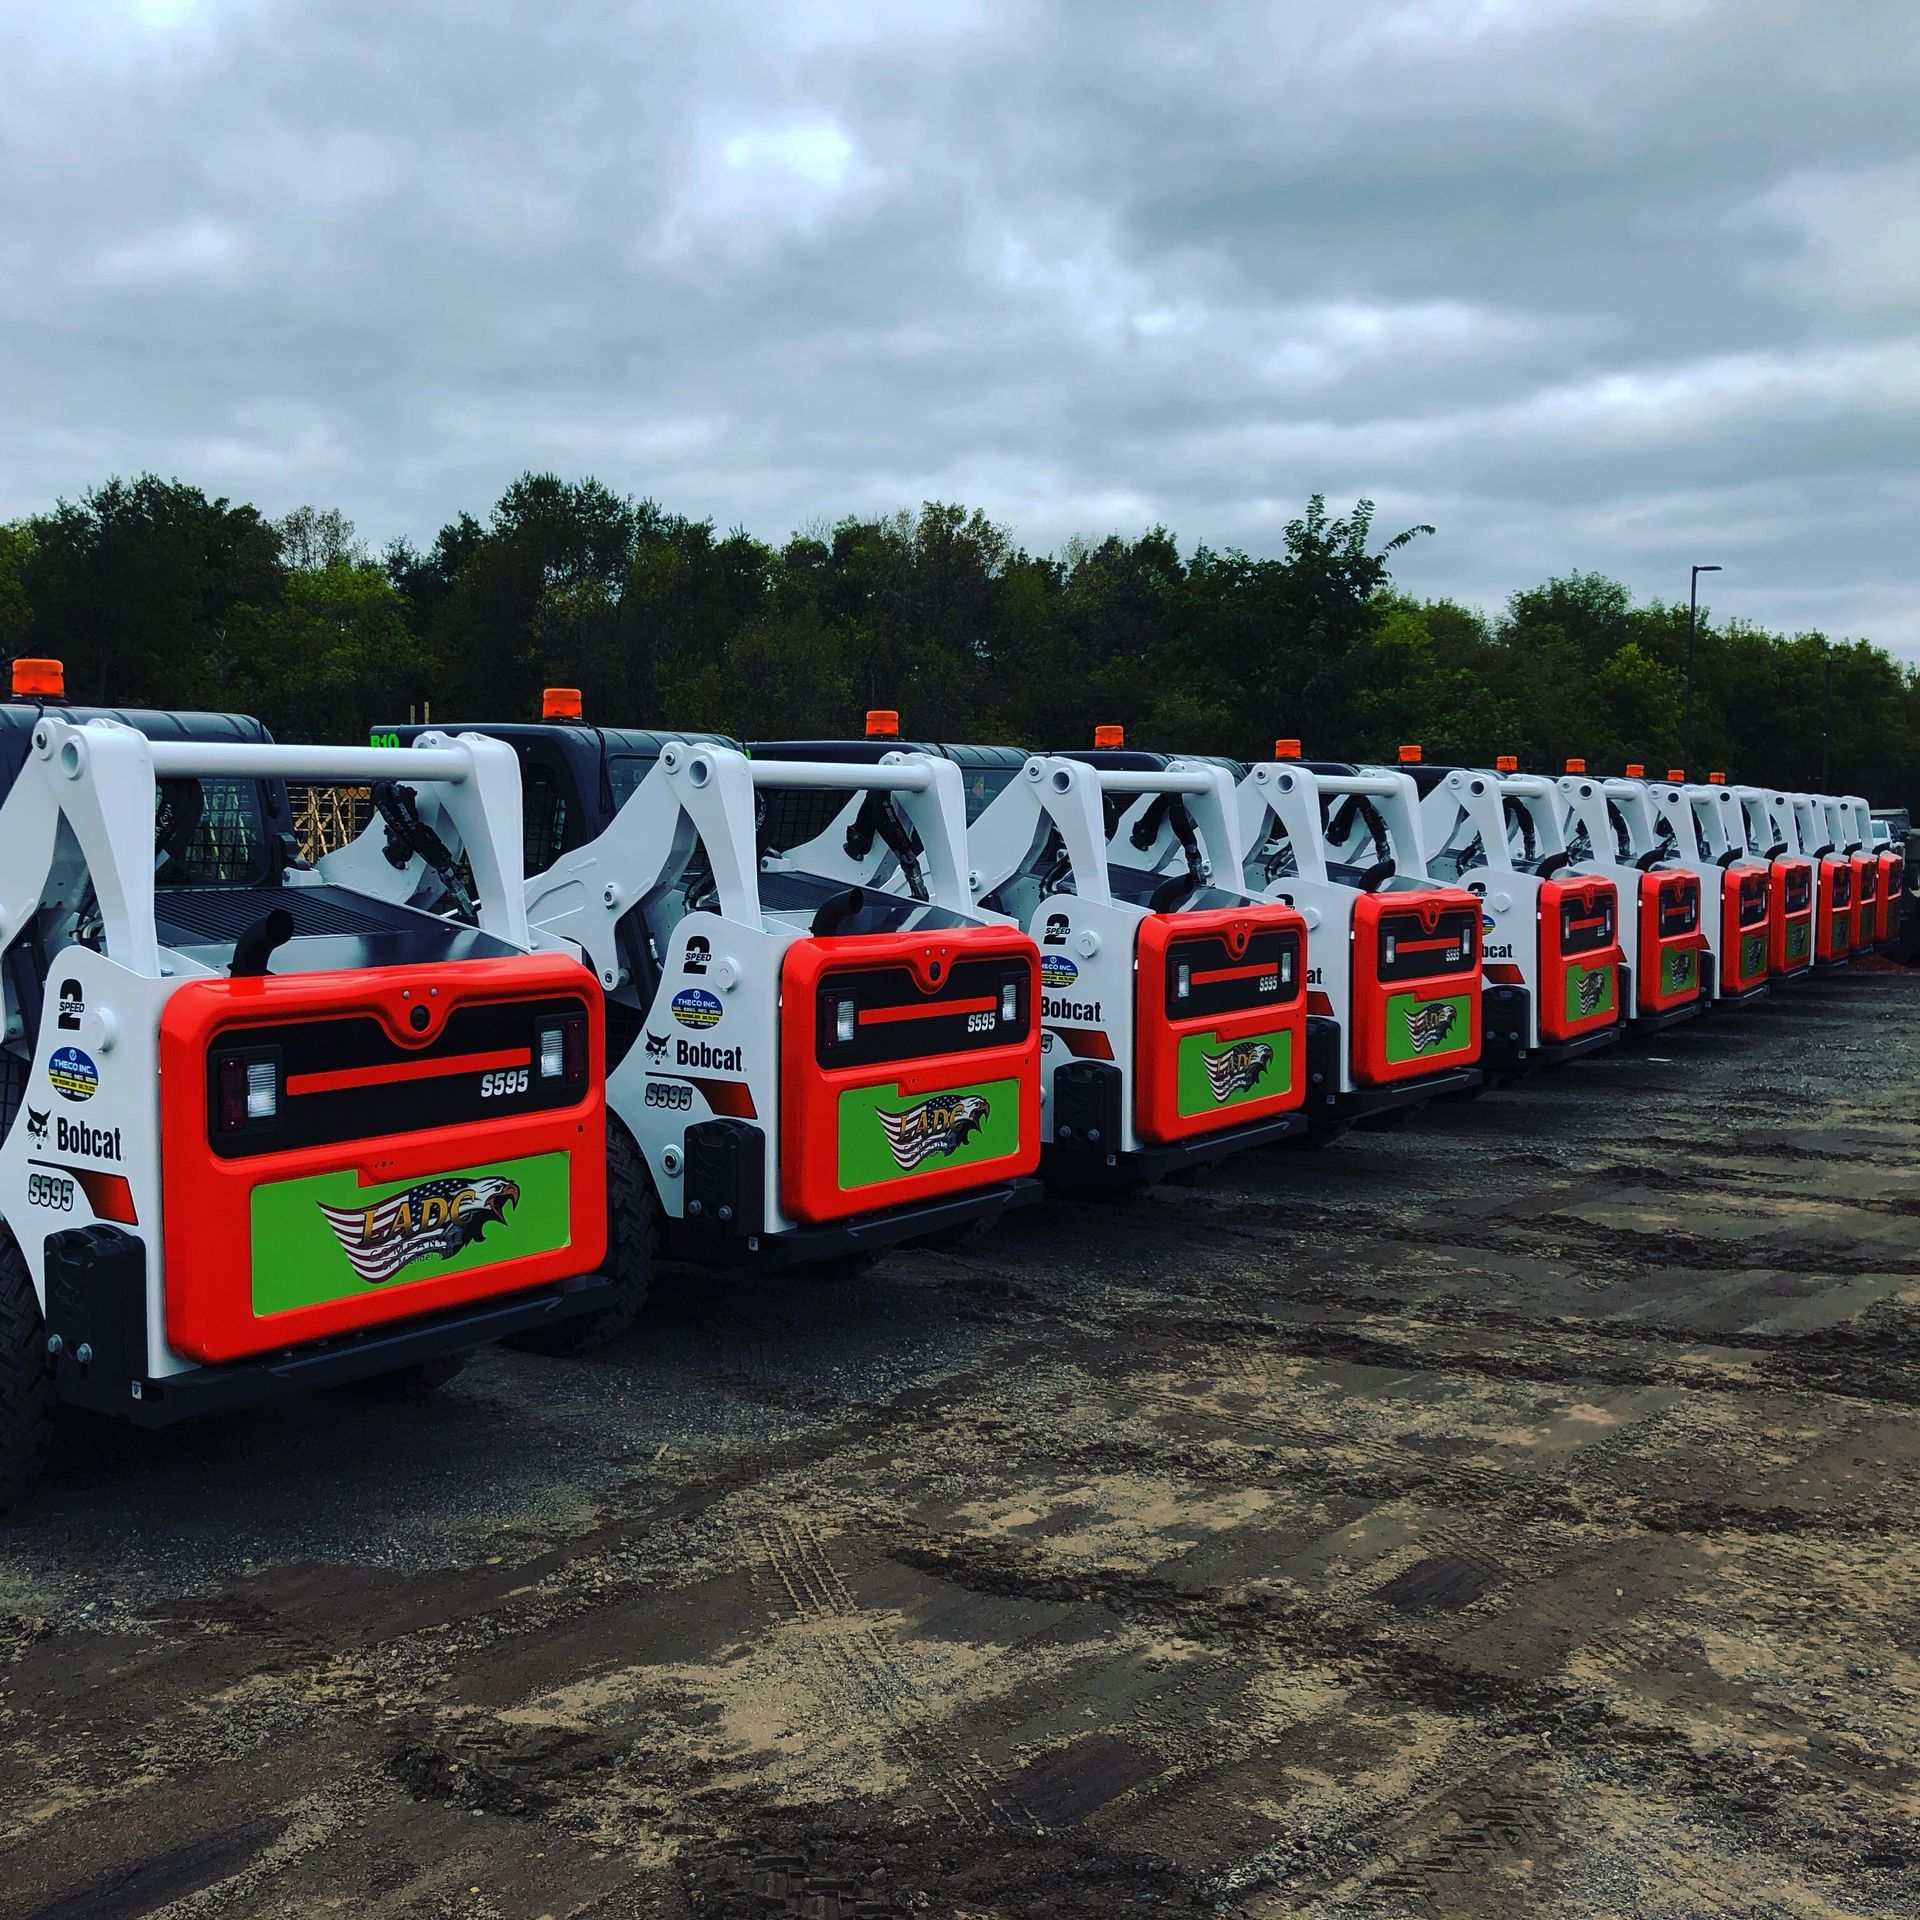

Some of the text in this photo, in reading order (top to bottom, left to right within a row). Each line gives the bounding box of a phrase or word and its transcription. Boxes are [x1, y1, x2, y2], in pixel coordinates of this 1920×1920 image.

[1043, 914, 1069, 945] 2
[1045, 927, 1071, 935] SPEED
[683, 936, 710, 975] 2
[685, 952, 712, 962] SPEED
[1482, 943, 1513, 958] bcat
[58, 978, 82, 1030] 2
[59, 1001, 85, 1013] SPEED
[677, 998, 702, 1007] THECO
[967, 1012, 996, 1033] S595
[54, 1058, 78, 1071] THECO
[676, 1039, 742, 1072] Bobcat
[480, 1069, 529, 1098] S595
[645, 1083, 693, 1111] S595
[896, 1104, 964, 1141] LADC
[57, 1116, 122, 1161] Bobcat
[28, 1173, 75, 1212] S595
[357, 1188, 477, 1246] LADC
